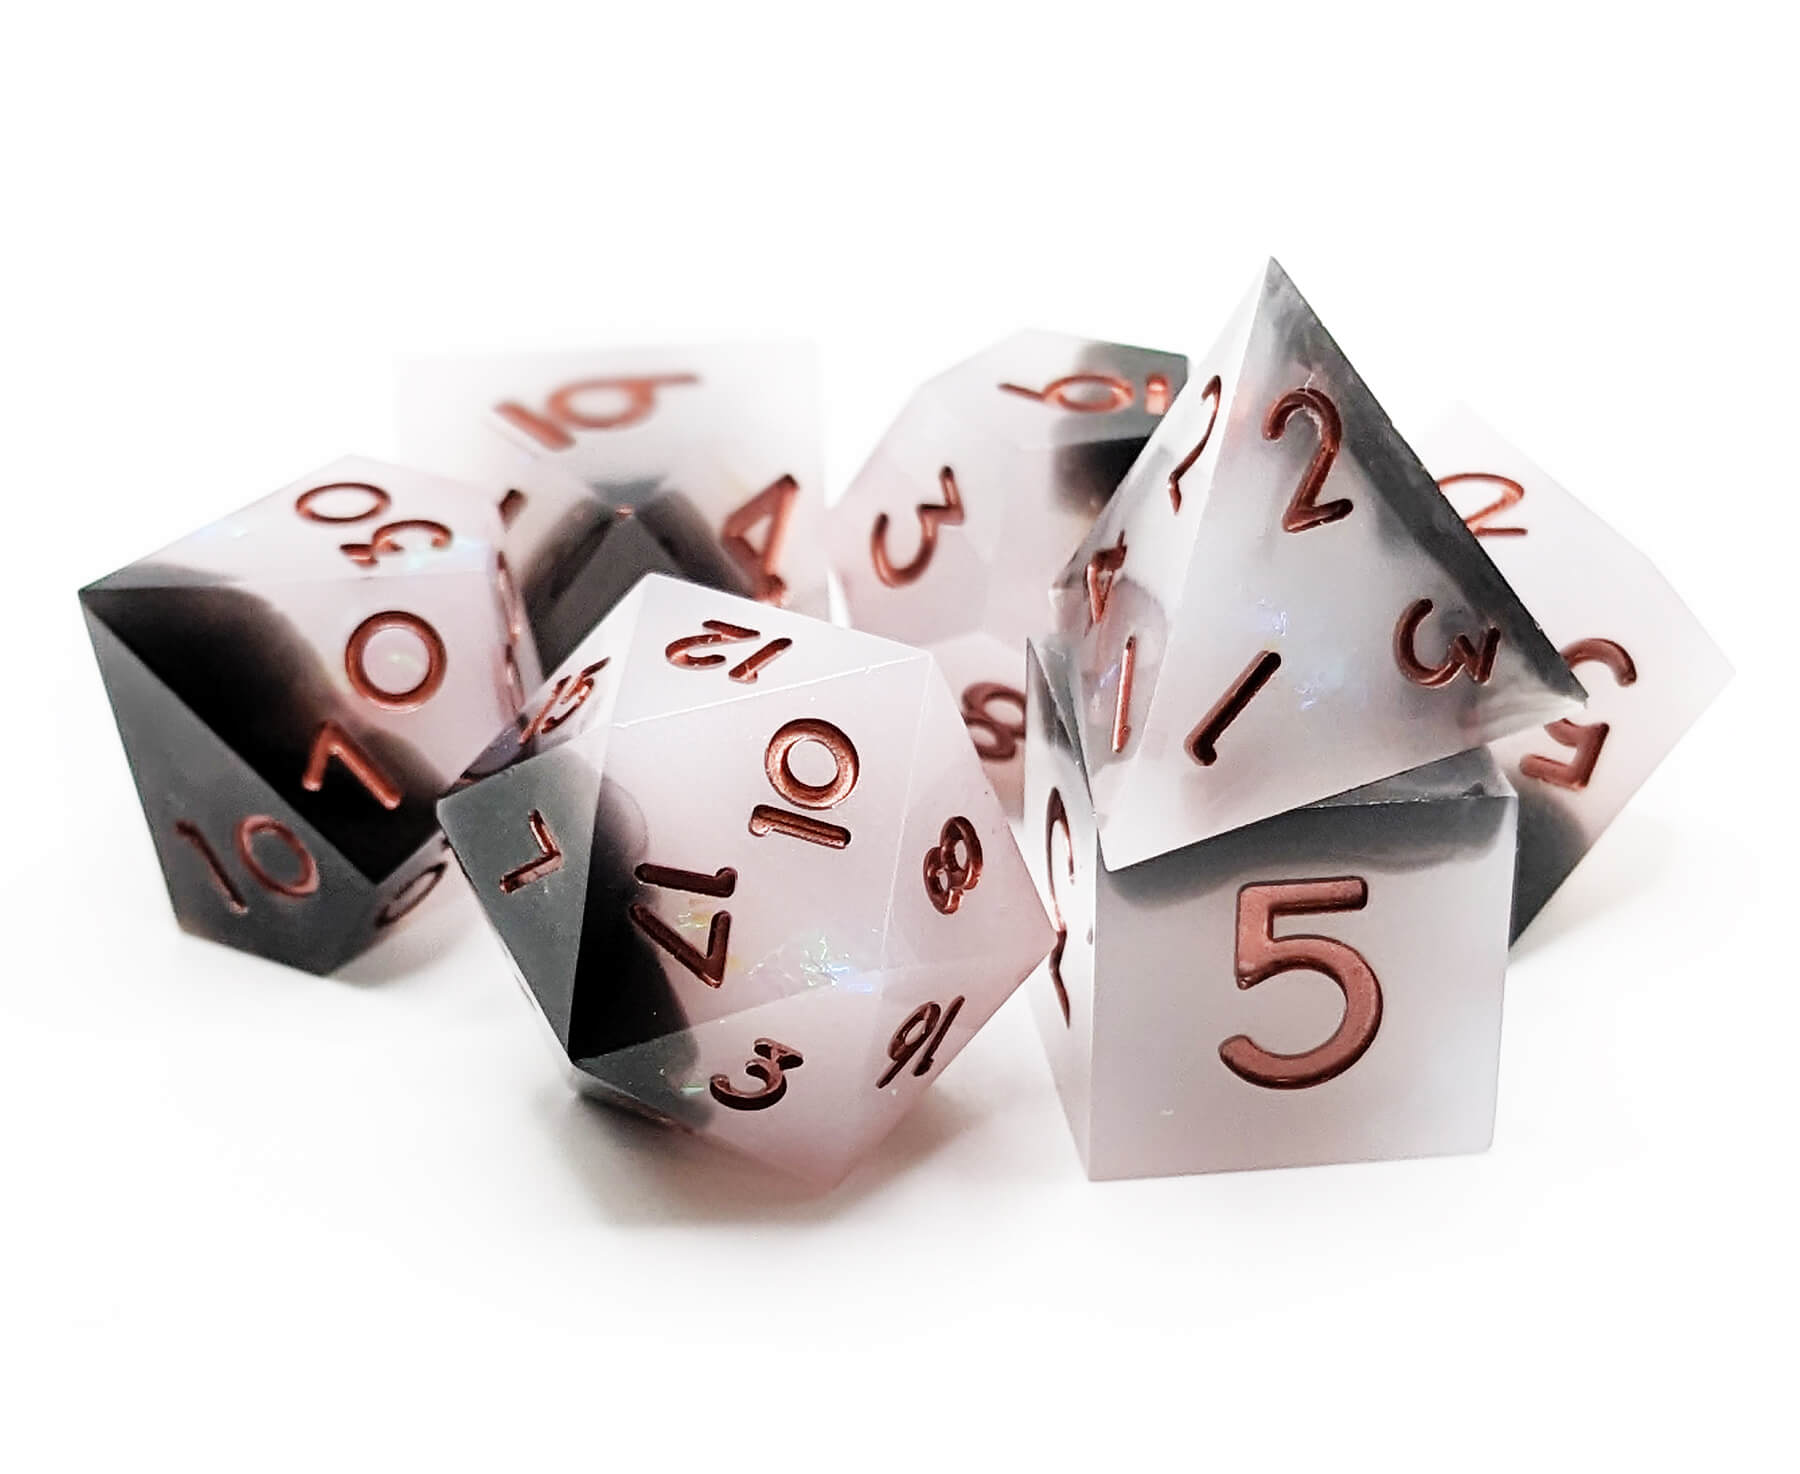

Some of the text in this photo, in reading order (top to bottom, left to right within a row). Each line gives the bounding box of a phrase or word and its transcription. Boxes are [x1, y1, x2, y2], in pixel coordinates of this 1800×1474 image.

[1168, 375, 1222, 514] 2
[1262, 387, 1355, 533] 2
[721, 474, 798, 607] 4
[871, 466, 965, 588] 3
[1438, 473, 1528, 535] 2
[519, 656, 611, 745] 15
[665, 620, 793, 684] 12
[1112, 635, 1137, 753] 1
[1393, 598, 1501, 689] 3
[1184, 648, 1282, 767] 1
[748, 718, 860, 850] 10
[175, 816, 320, 913] 10
[500, 809, 562, 893] 7
[923, 816, 983, 915] 8
[630, 862, 738, 989] 17
[1218, 876, 1384, 1091] 5
[709, 1037, 804, 1111] 3
